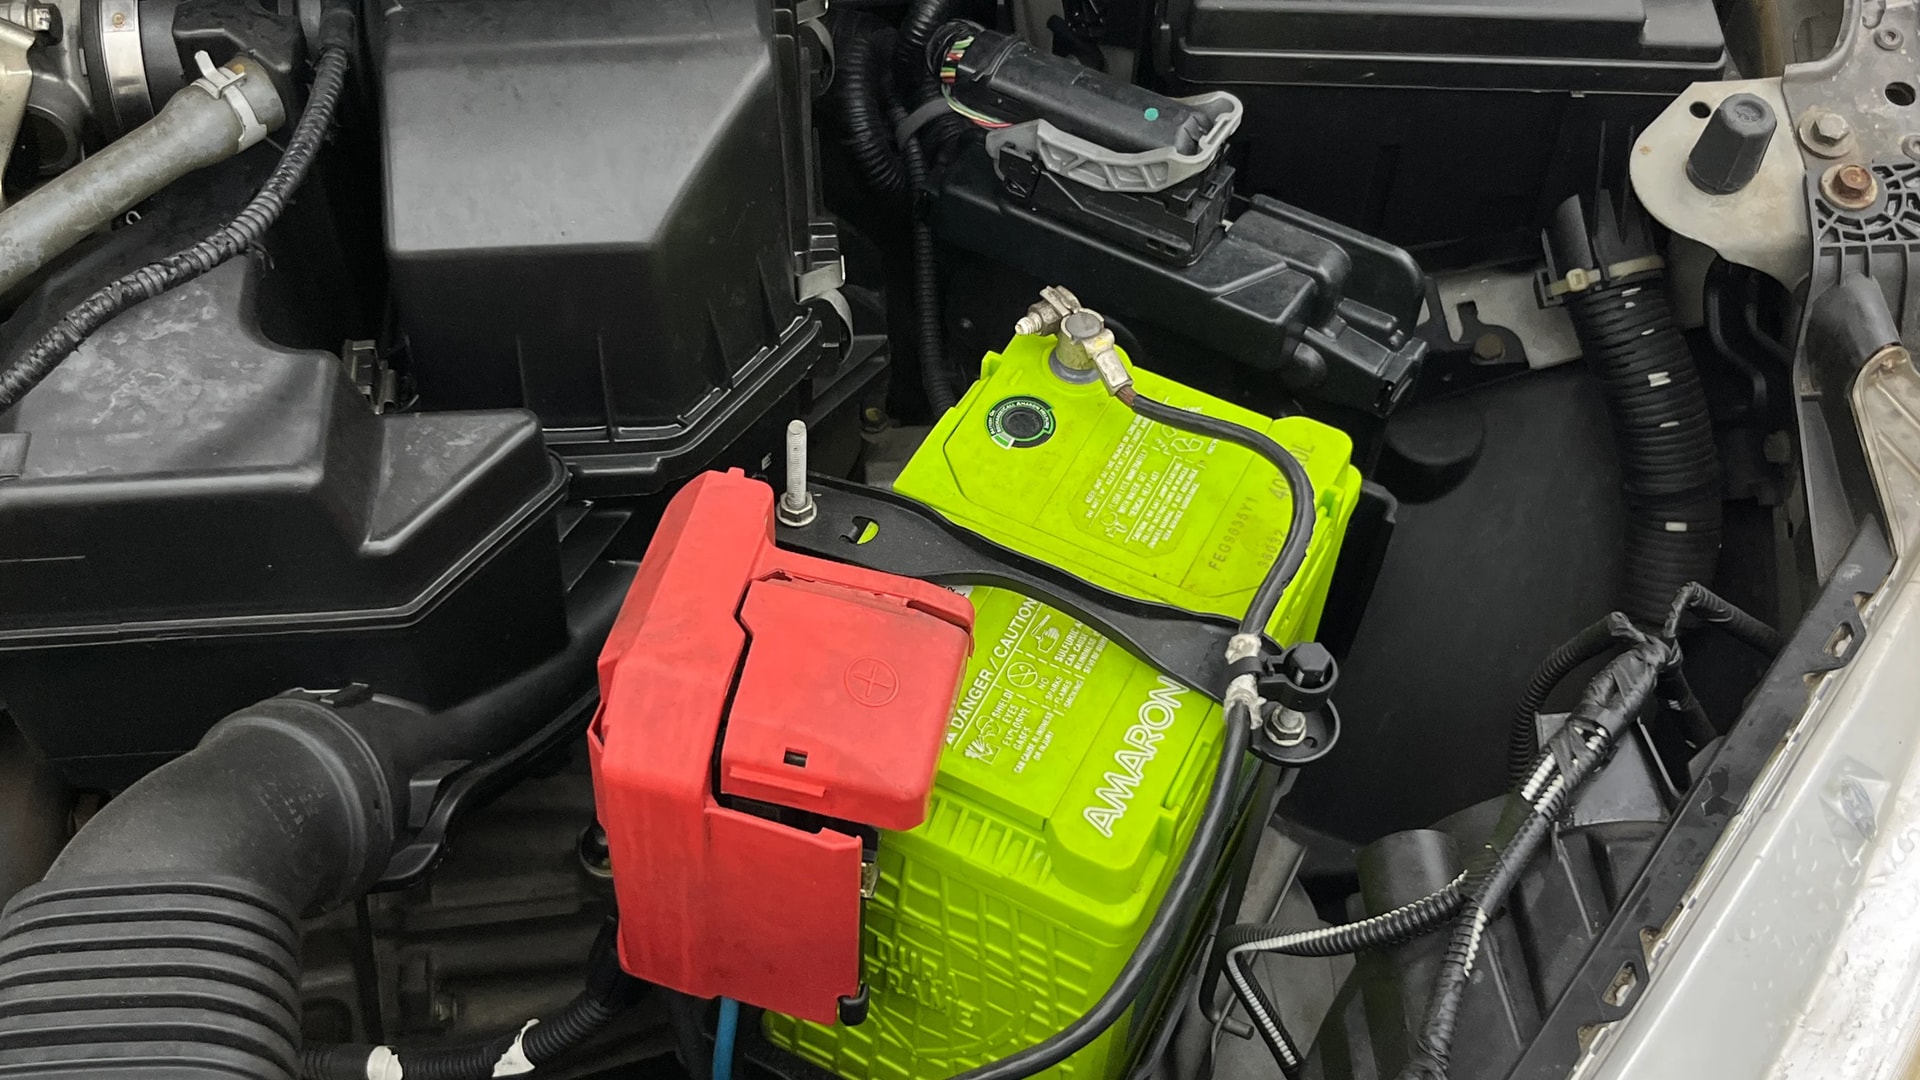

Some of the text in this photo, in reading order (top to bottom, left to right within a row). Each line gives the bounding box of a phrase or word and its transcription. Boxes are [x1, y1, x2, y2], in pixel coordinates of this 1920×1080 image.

[1054, 628, 1079, 662] SULFURIC
[1074, 638, 1096, 670] BLINDNESS
[951, 669, 994, 729] DANGER
[993, 596, 1037, 658] CAUTION
[1037, 677, 1049, 689] NO
[1045, 676, 1063, 700] SPARKS
[1054, 680, 1072, 703] FLAMES
[1002, 704, 1018, 723] EYES
[1002, 707, 1030, 746] EXPLOSIVE
[1013, 726, 1030, 750] GASES
[1083, 675, 1190, 838] AMARON
